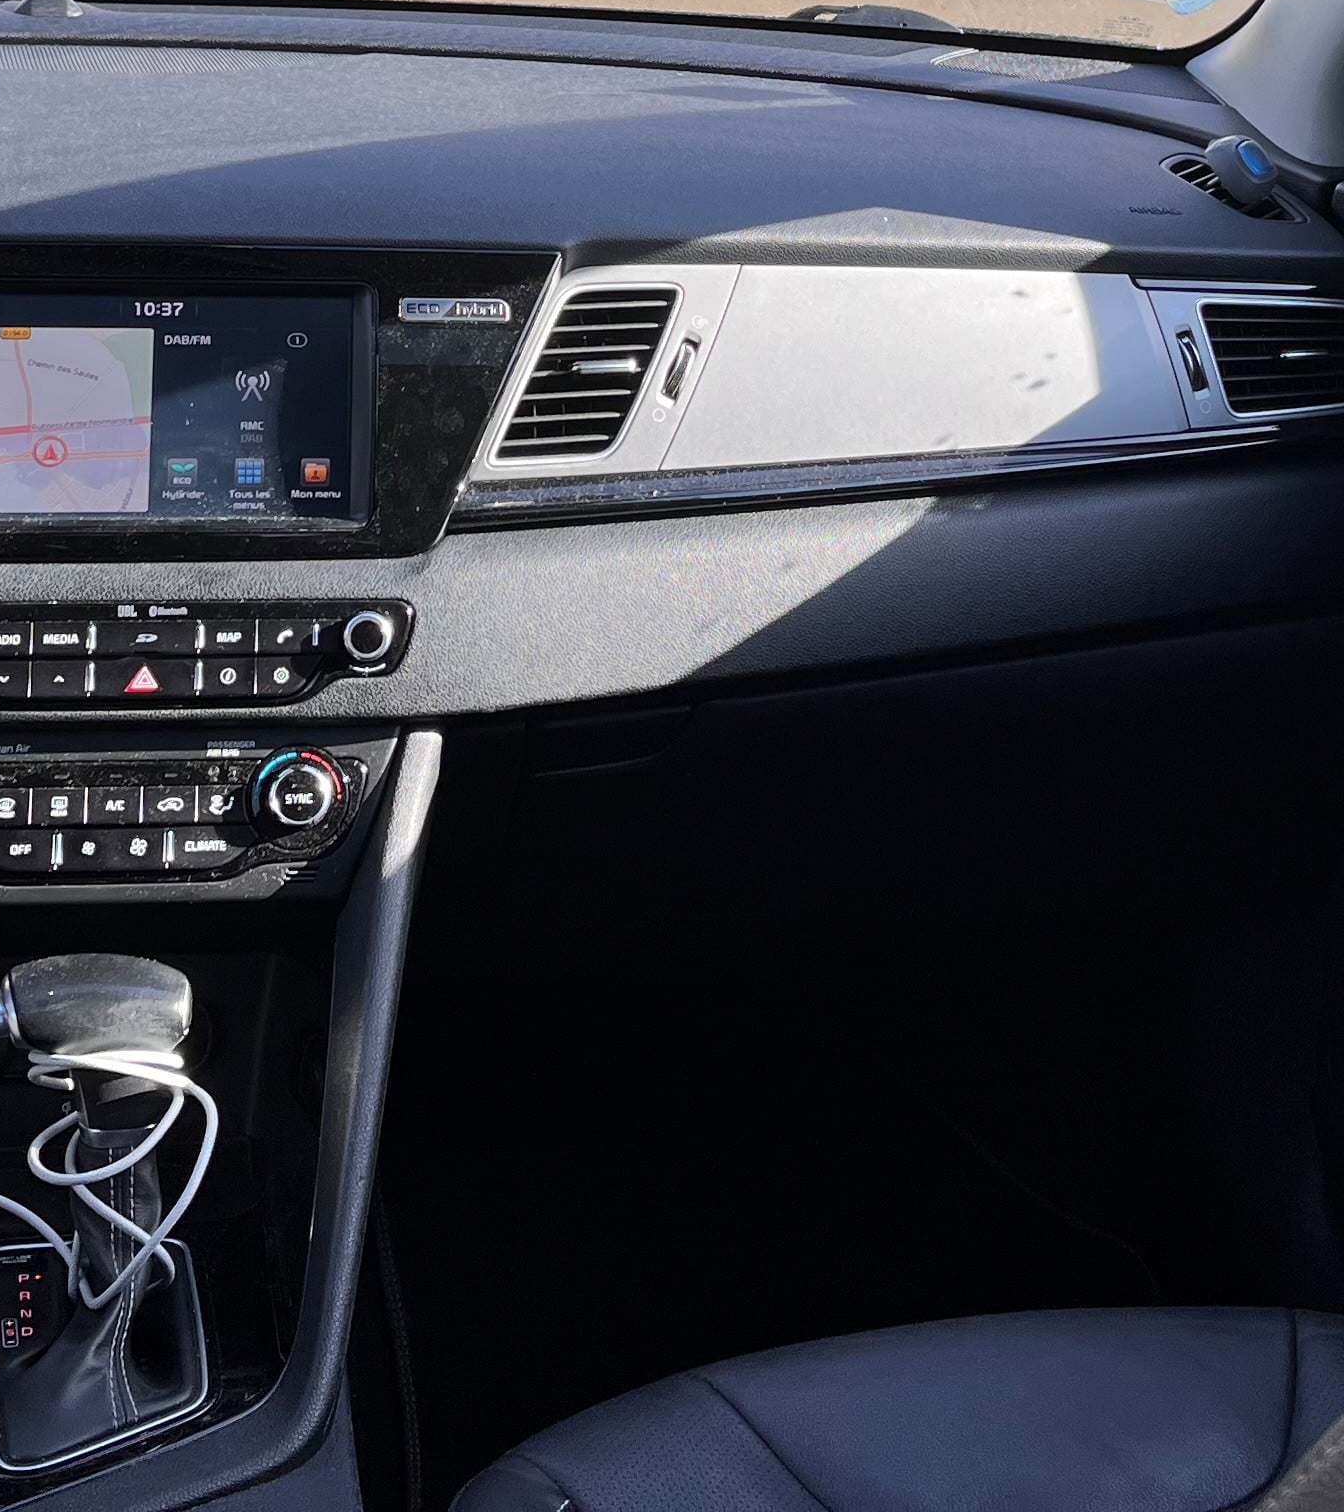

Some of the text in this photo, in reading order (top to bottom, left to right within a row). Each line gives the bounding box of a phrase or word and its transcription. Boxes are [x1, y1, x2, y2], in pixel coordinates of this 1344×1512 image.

[134, 302, 184, 317] 10:37
[406, 302, 504, 318] ECO hybrid
[164, 335, 212, 346] DAB/FM
[27, 359, 99, 382] Chemin des Saules
[240, 421, 265, 431] RMC
[172, 477, 192, 485] ECO
[228, 489, 271, 499] Tous les
[290, 489, 342, 499] Mon menu
[233, 501, 265, 510] menus
[43, 633, 79, 645] MEDIA
[216, 631, 242, 643] MAP
[15, 743, 32, 752] Air
[284, 793, 314, 805] SYNC
[105, 799, 126, 811] A/C
[9, 843, 32, 856] OFF
[184, 840, 227, 852] CLIMATE
[18, 1273, 30, 1284] P
[19, 1291, 31, 1301] R
[20, 1309, 32, 1319] N
[21, 1326, 33, 1337] D
